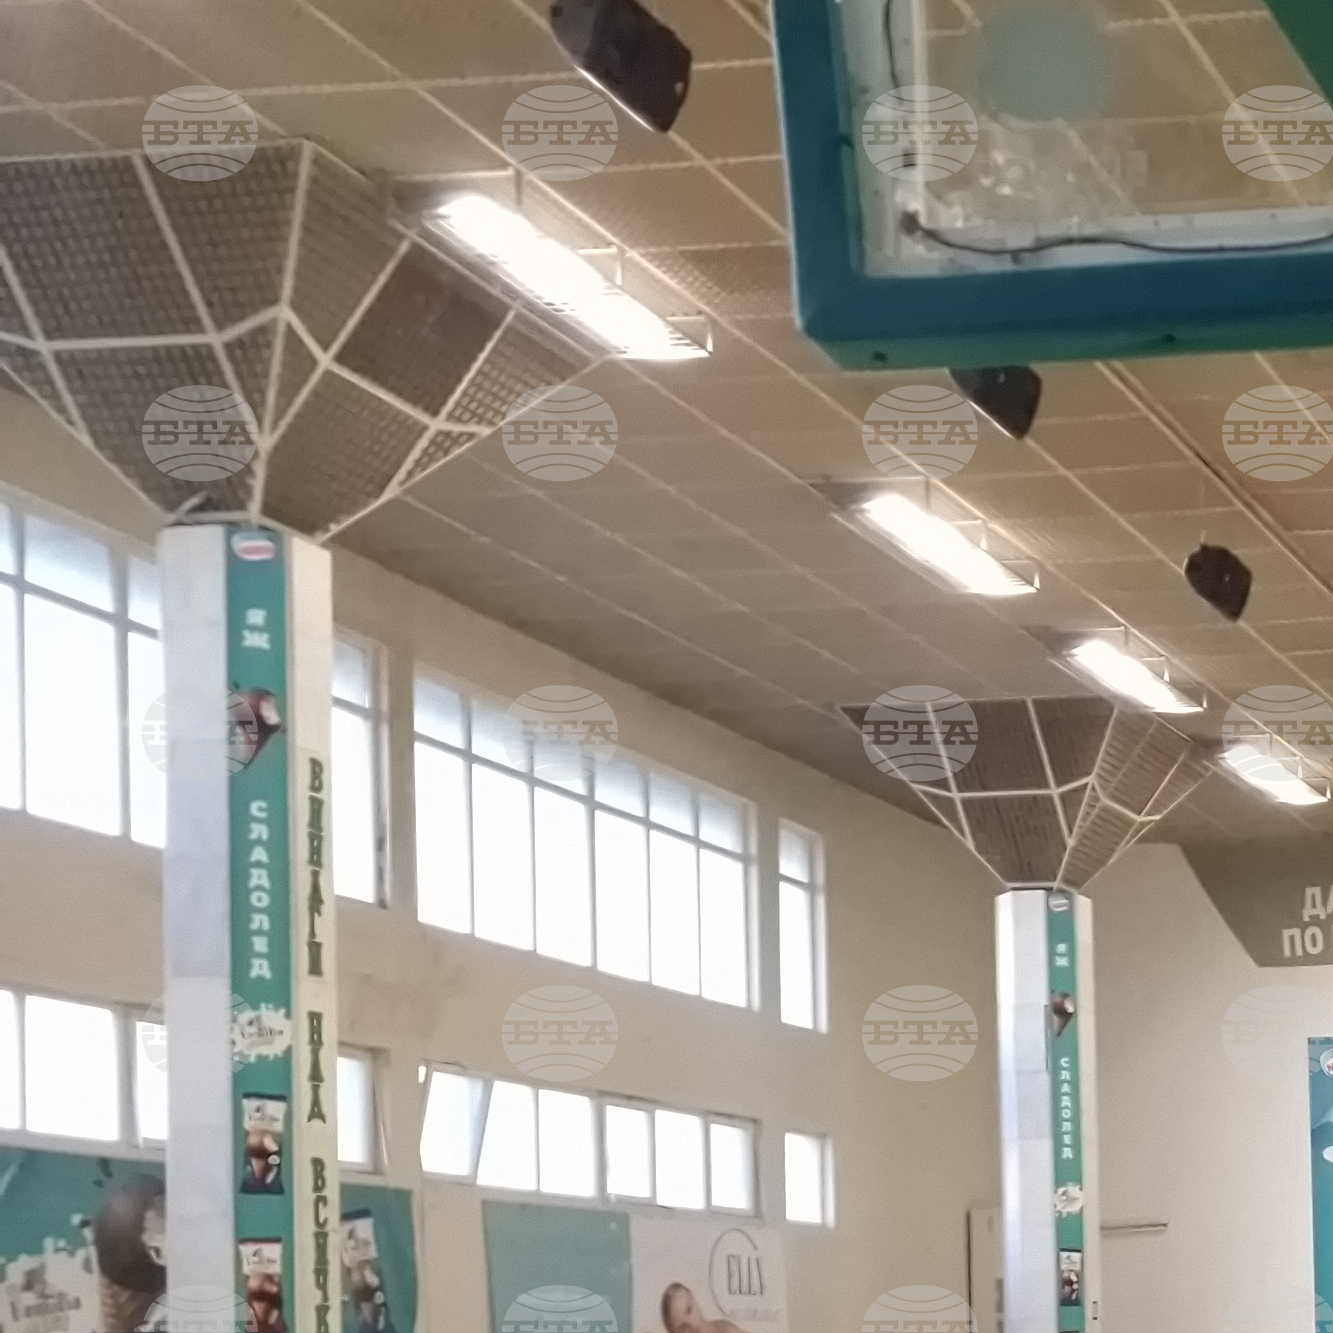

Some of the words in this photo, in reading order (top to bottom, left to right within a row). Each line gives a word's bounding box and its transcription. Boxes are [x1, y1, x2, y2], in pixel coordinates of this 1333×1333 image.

[249, 800, 272, 980] СЛАДОЛЕД
[307, 757, 325, 977] ВИНАГИ
[1282, 925, 1324, 957] ПО
[306, 1010, 327, 1125] НАД
